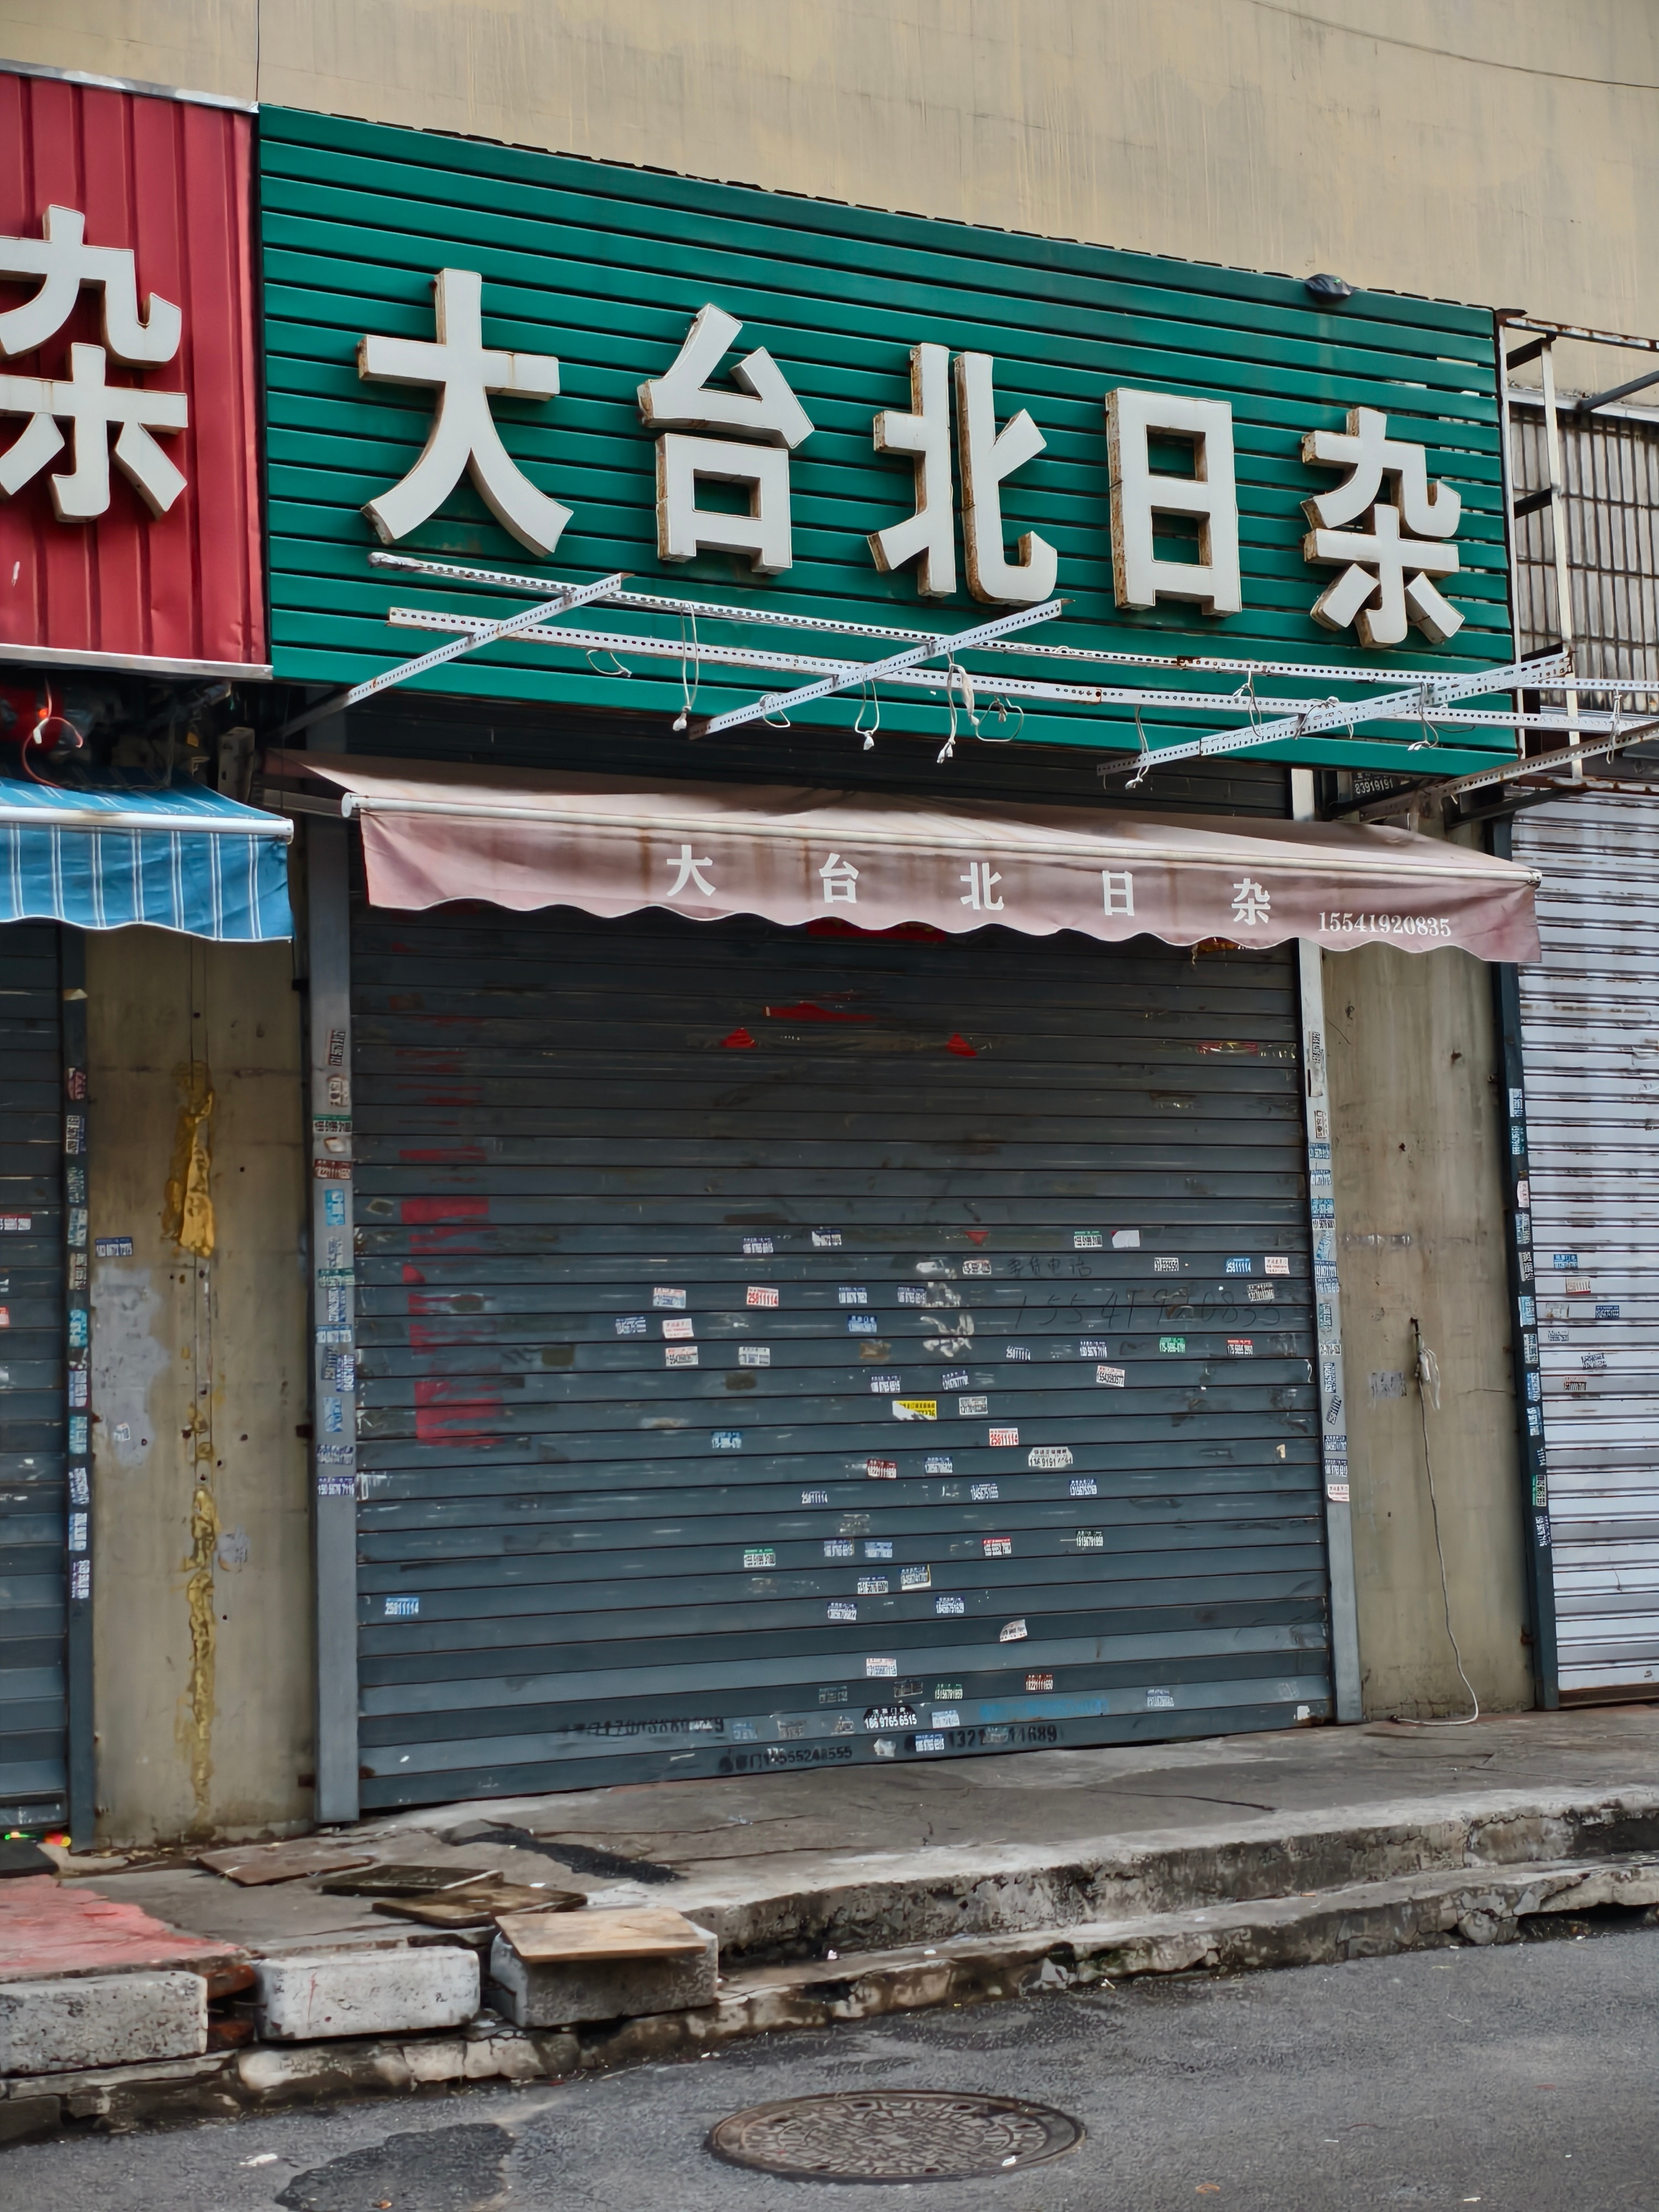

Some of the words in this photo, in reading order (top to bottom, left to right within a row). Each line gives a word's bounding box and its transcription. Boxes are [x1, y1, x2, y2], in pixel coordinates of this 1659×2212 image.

[0, 204, 188, 523] 杂
[356, 268, 1466, 648] 大台北日杂
[666, 844, 1271, 926] 大台北日杂
[1319, 911, 1452, 938] 15541920835
